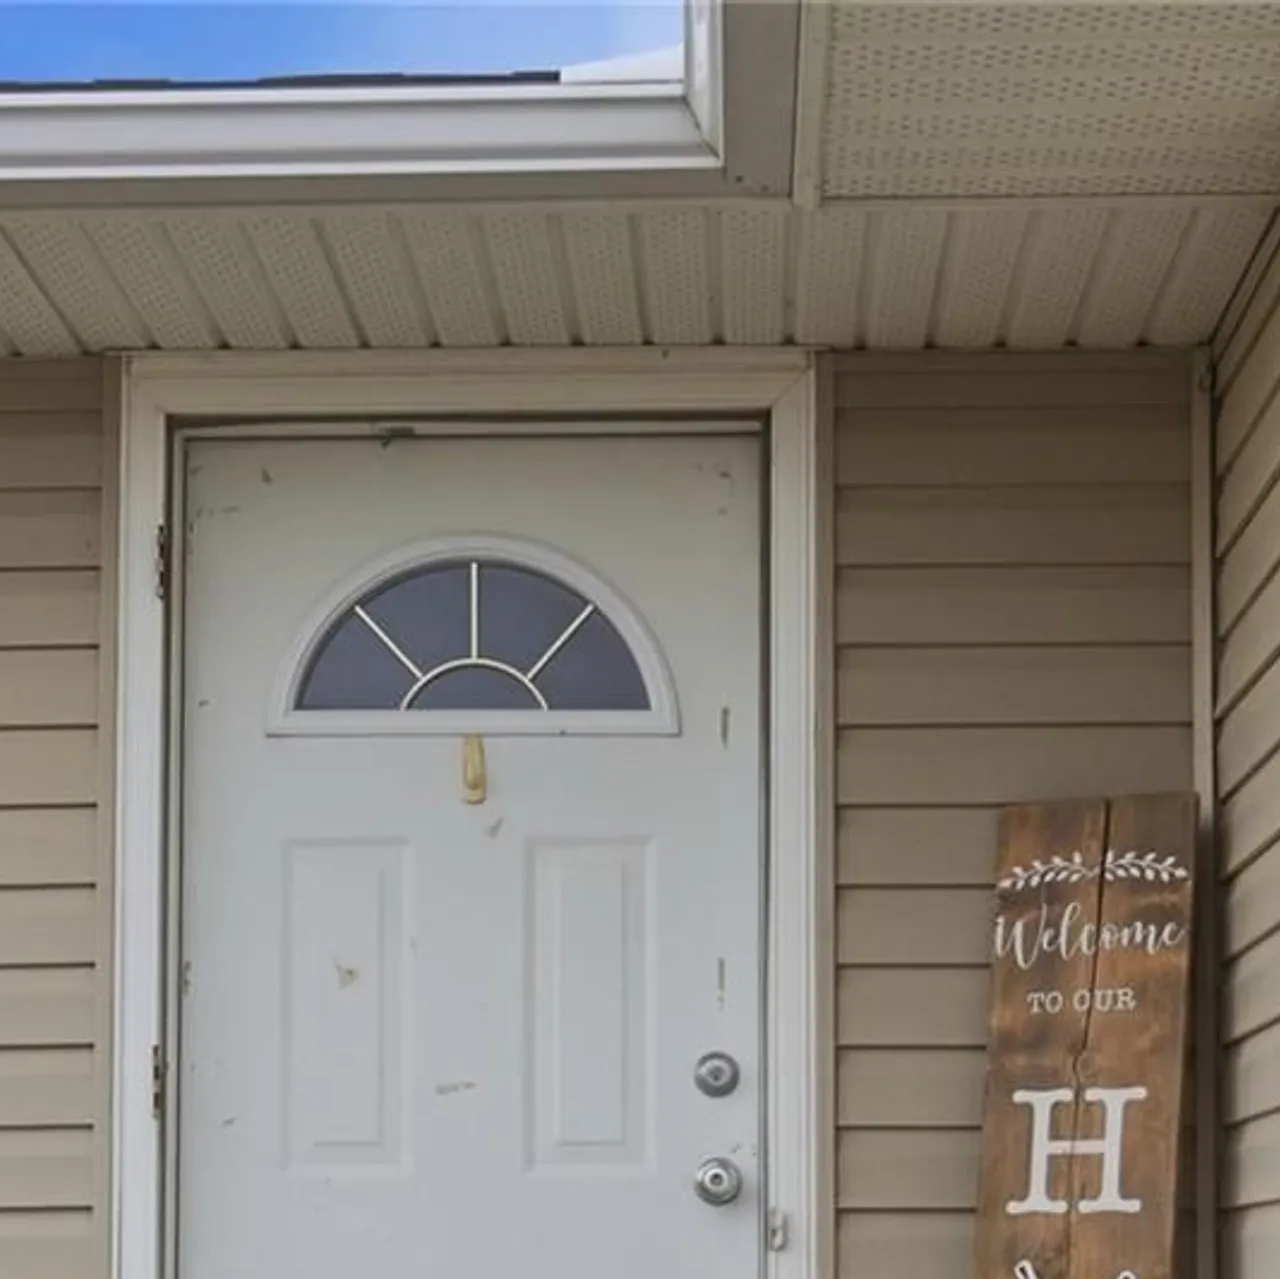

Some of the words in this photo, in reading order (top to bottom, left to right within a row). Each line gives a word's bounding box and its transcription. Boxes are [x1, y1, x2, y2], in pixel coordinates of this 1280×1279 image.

[994, 902, 1184, 969] Welcome
[1026, 990, 1064, 1015] TO
[1072, 987, 1136, 1012] OUR
